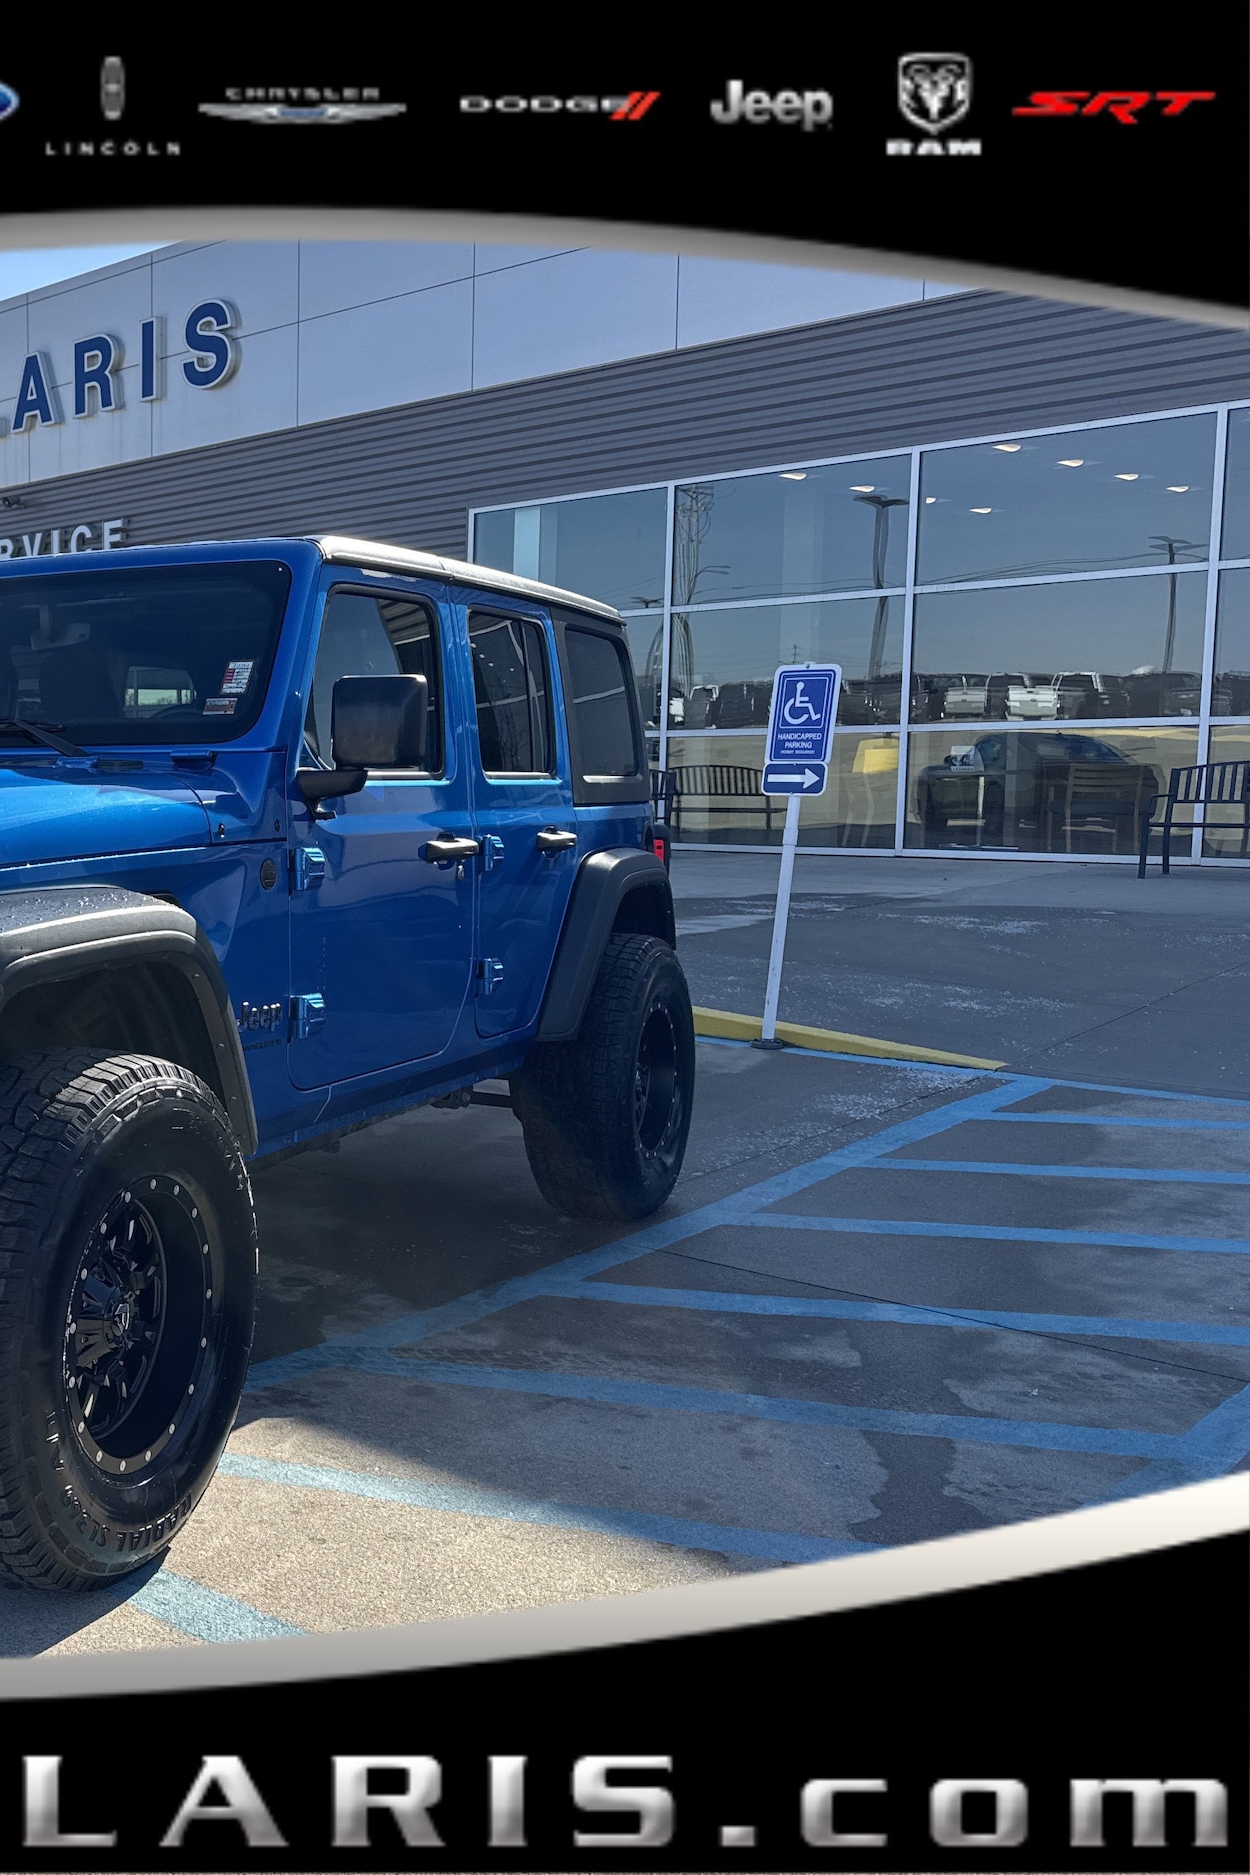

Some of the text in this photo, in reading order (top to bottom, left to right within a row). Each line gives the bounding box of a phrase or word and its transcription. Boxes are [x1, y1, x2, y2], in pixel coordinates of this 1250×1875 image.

[777, 732, 822, 740] HANDICAPPED
[784, 741, 813, 749] PARKING
[116, 1490, 192, 1553] RADIAL
